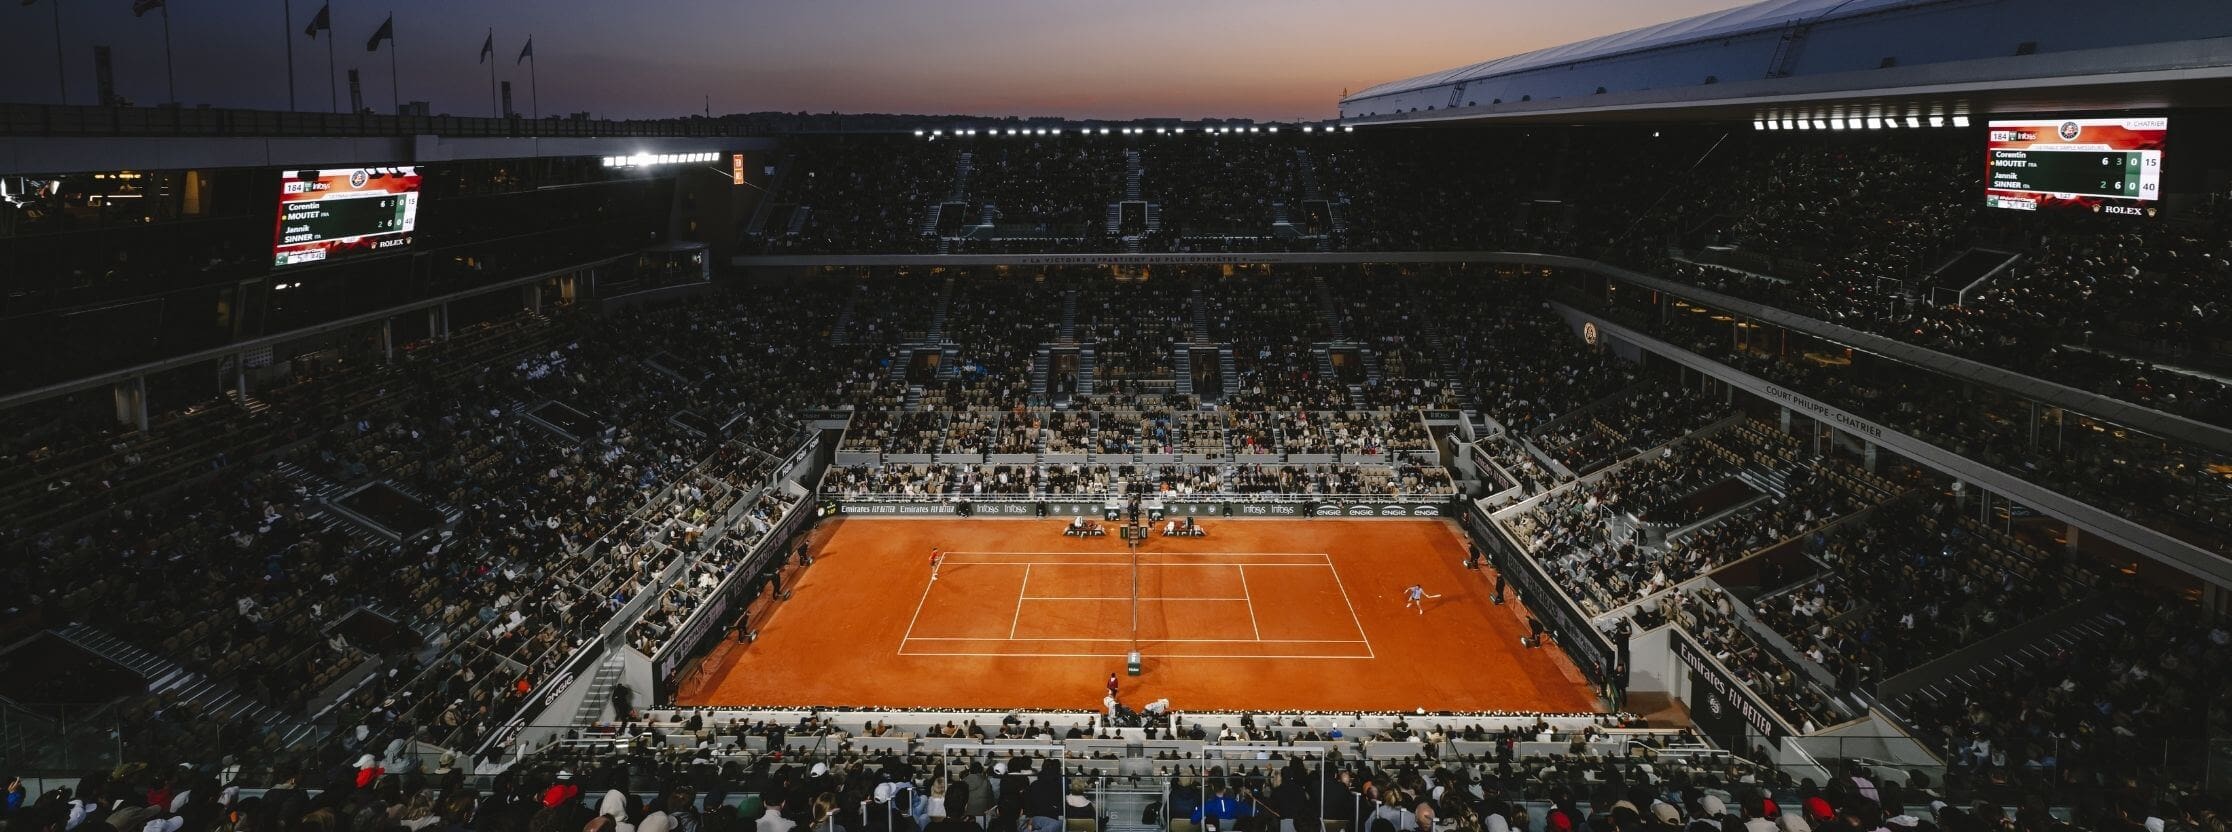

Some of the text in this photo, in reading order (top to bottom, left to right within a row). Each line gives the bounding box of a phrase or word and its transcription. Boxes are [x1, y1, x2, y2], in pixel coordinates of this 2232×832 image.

[1995, 151, 2027, 159] Corentin
[1995, 160, 2027, 168] MOUTET
[2102, 157, 2109, 165] 6
[2131, 158, 2137, 166] 0
[2145, 158, 2157, 166] 15
[1994, 172, 2018, 180] Jannik
[1993, 181, 2022, 189] SINNER
[2100, 181, 2155, 191] 2 6 0 40
[288, 202, 320, 211] Corentin
[380, 200, 386, 208] 6
[2105, 205, 2142, 216] ROLEX
[287, 211, 320, 220] MOUTET
[387, 219, 393, 227] 6
[396, 218, 402, 226] 0
[285, 225, 310, 234] Jannik
[284, 234, 313, 243] SINNER
[379, 239, 404, 248] ROLEX
[1766, 385, 1792, 401] COURT
[1793, 396, 1829, 417] PHILIPPE
[1836, 413, 1882, 438] CHATRIER
[841, 505, 870, 513] Emirates
[900, 505, 929, 513] Emirates
[977, 504, 999, 514] Infosys
[1004, 504, 1027, 514] Infosys
[1243, 504, 1266, 514] Infosys
[1271, 504, 1294, 514] Infosys
[1681, 642, 1725, 695] Emirates
[1728, 687, 1743, 711] FLY
[1742, 700, 1772, 736] BETTER
